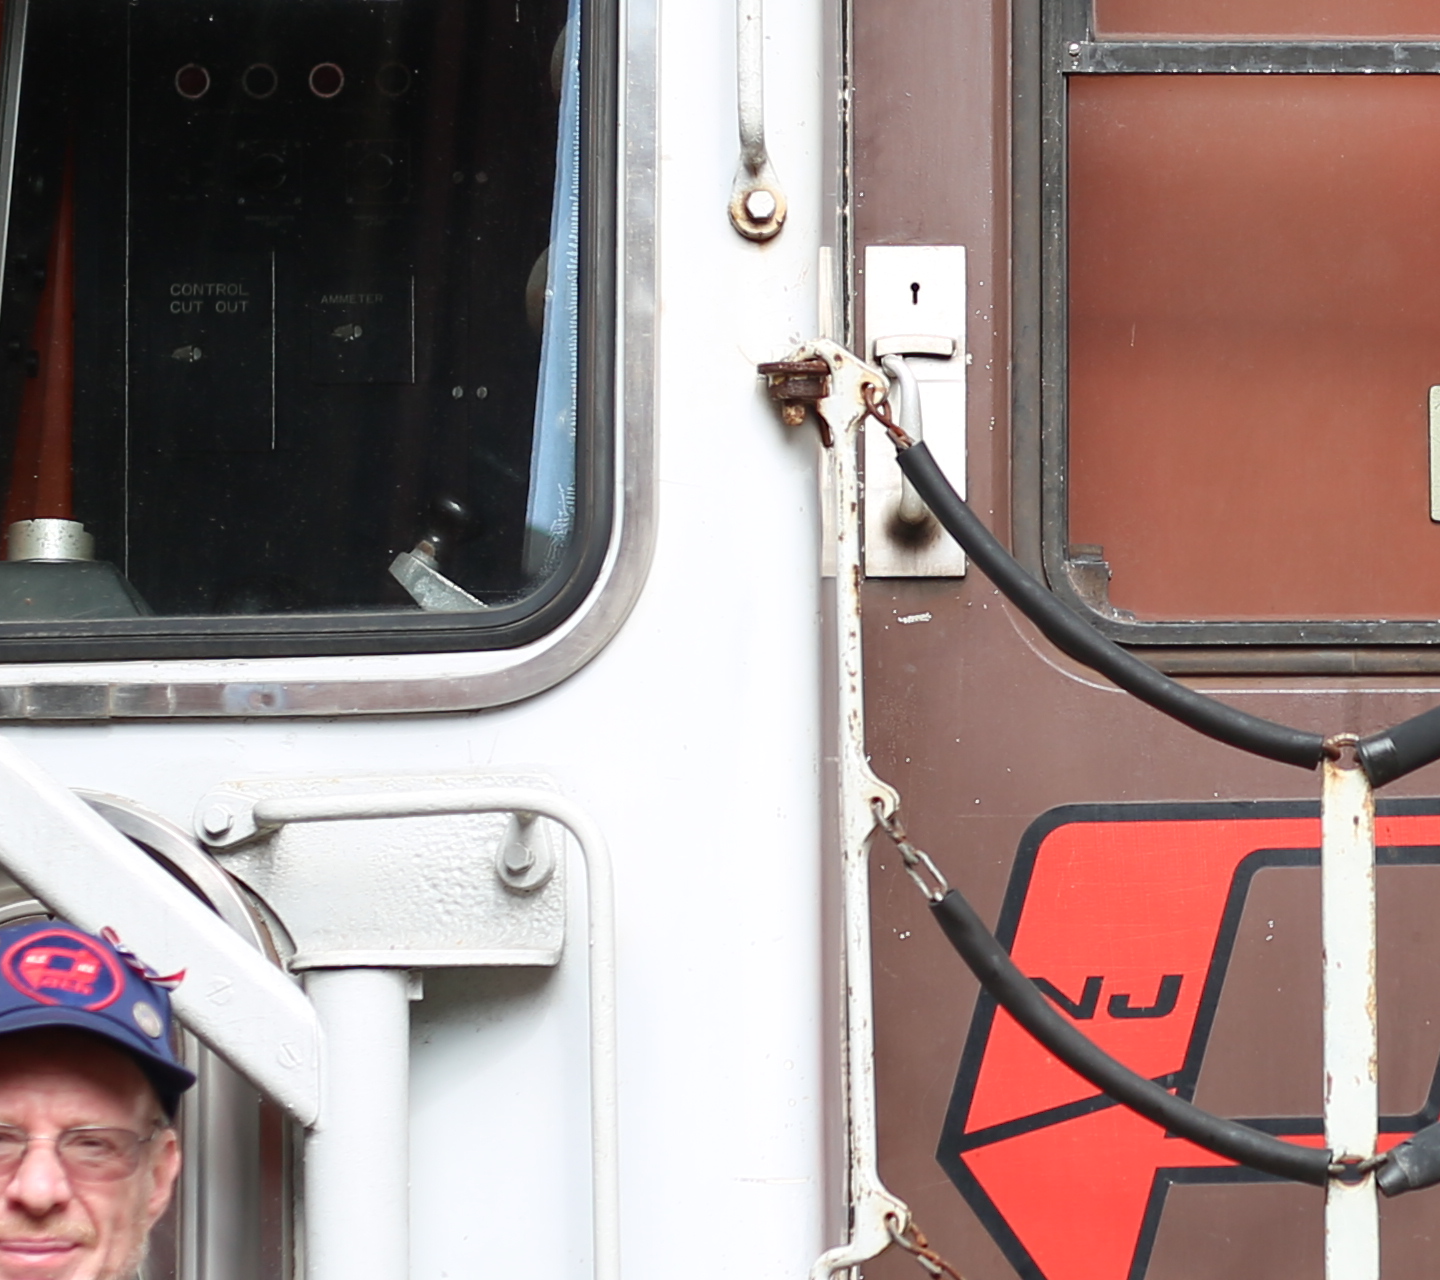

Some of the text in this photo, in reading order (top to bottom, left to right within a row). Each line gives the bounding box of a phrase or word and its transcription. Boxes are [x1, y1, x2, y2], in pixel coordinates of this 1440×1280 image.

[169, 283, 250, 296] CONTROL
[320, 293, 384, 305] AMMETER
[169, 300, 250, 314] CUT OUT
